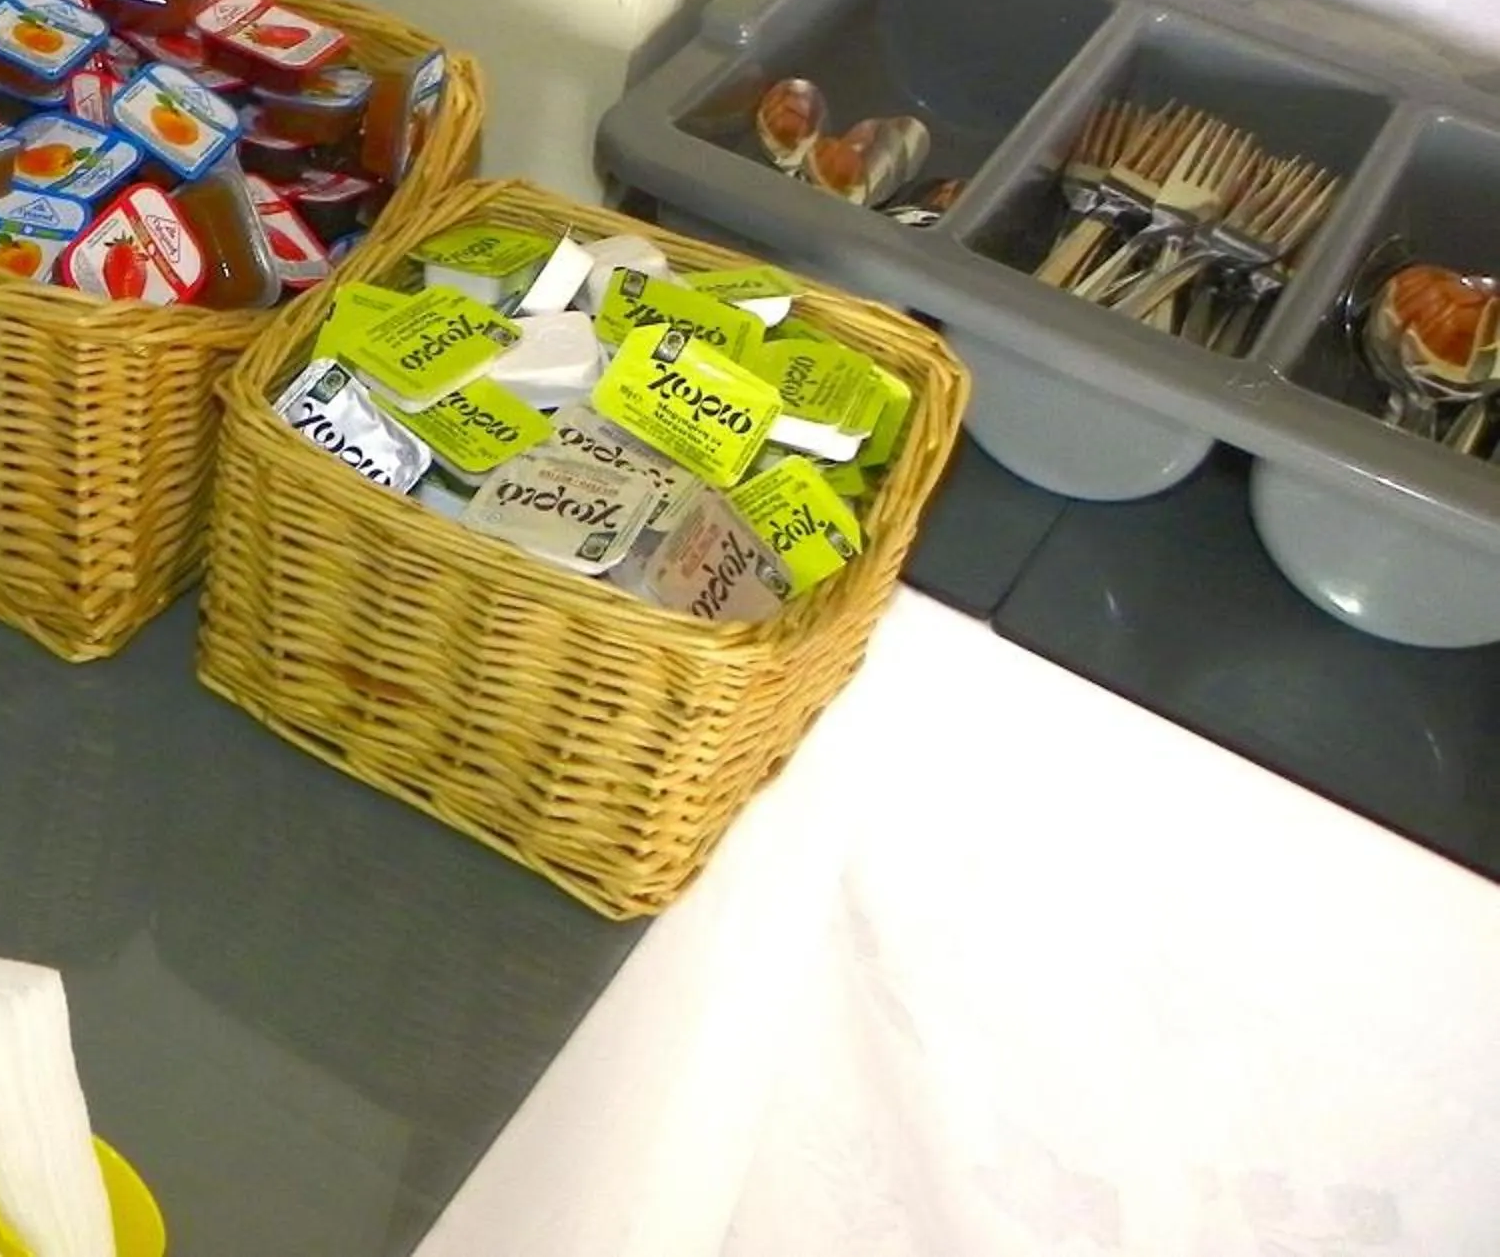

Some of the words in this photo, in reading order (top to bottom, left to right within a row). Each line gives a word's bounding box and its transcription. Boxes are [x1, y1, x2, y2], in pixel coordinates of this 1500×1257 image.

[434, 391, 520, 444] ωριό
[646, 362, 753, 435] χωριό
[496, 478, 625, 530] χωριό
